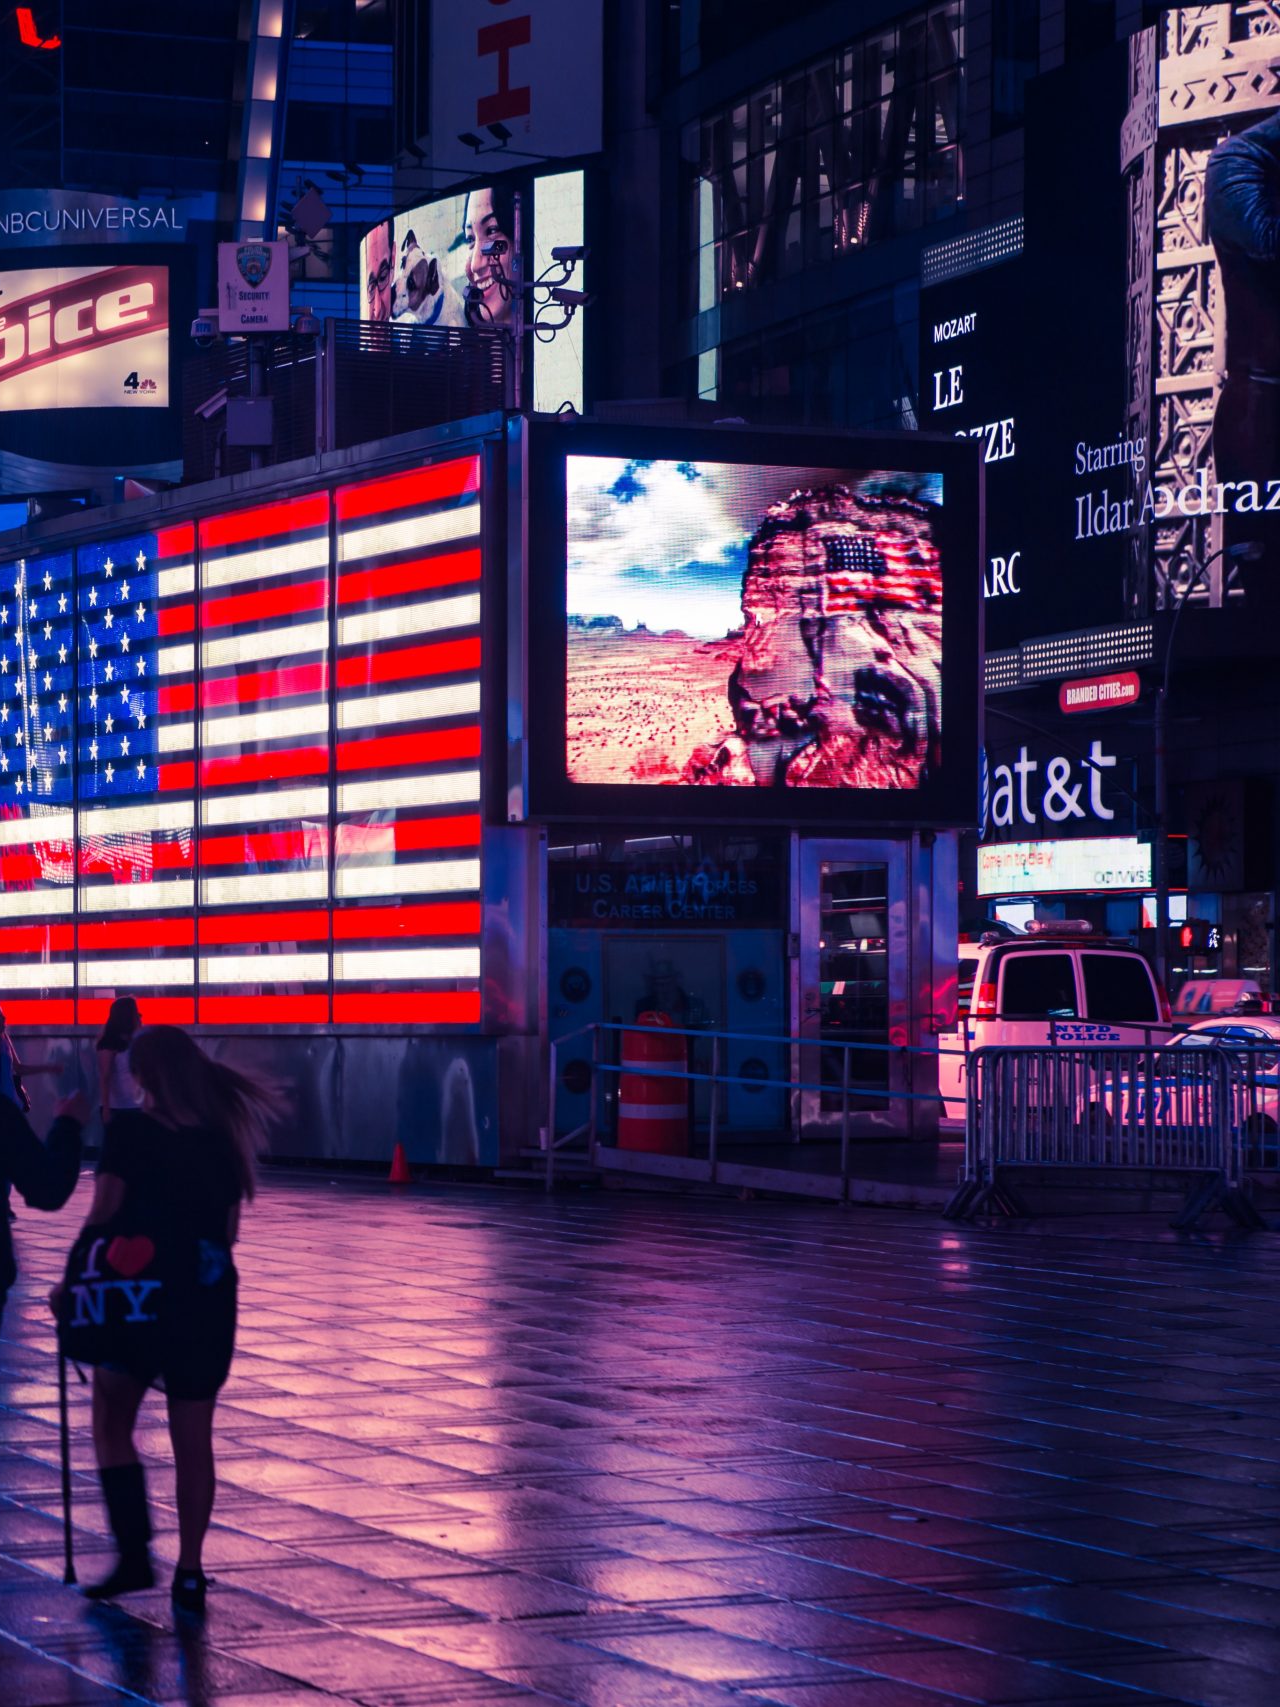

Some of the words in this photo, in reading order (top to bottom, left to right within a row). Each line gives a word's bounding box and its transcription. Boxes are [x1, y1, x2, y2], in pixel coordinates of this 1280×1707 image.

[238, 291, 269, 301] SECURITY
[241, 314, 268, 324] CAMERA
[934, 313, 977, 343] MOZART
[124, 371, 140, 390] 4
[933, 365, 963, 411] LE
[1075, 432, 1146, 474] Starring
[1075, 489, 1133, 540] Ildar
[984, 551, 1020, 598] RC
[1066, 685, 1098, 705] BRANDED
[992, 741, 1117, 826] at&t
[576, 874, 617, 893] U.S.
[592, 899, 663, 919] CAREER
[669, 899, 736, 920] CENTER
[1046, 1033, 1120, 1041] POLICE
[1055, 1024, 1112, 1033] NYPD
[81, 1238, 105, 1279] I
[71, 1279, 162, 1326] NY
